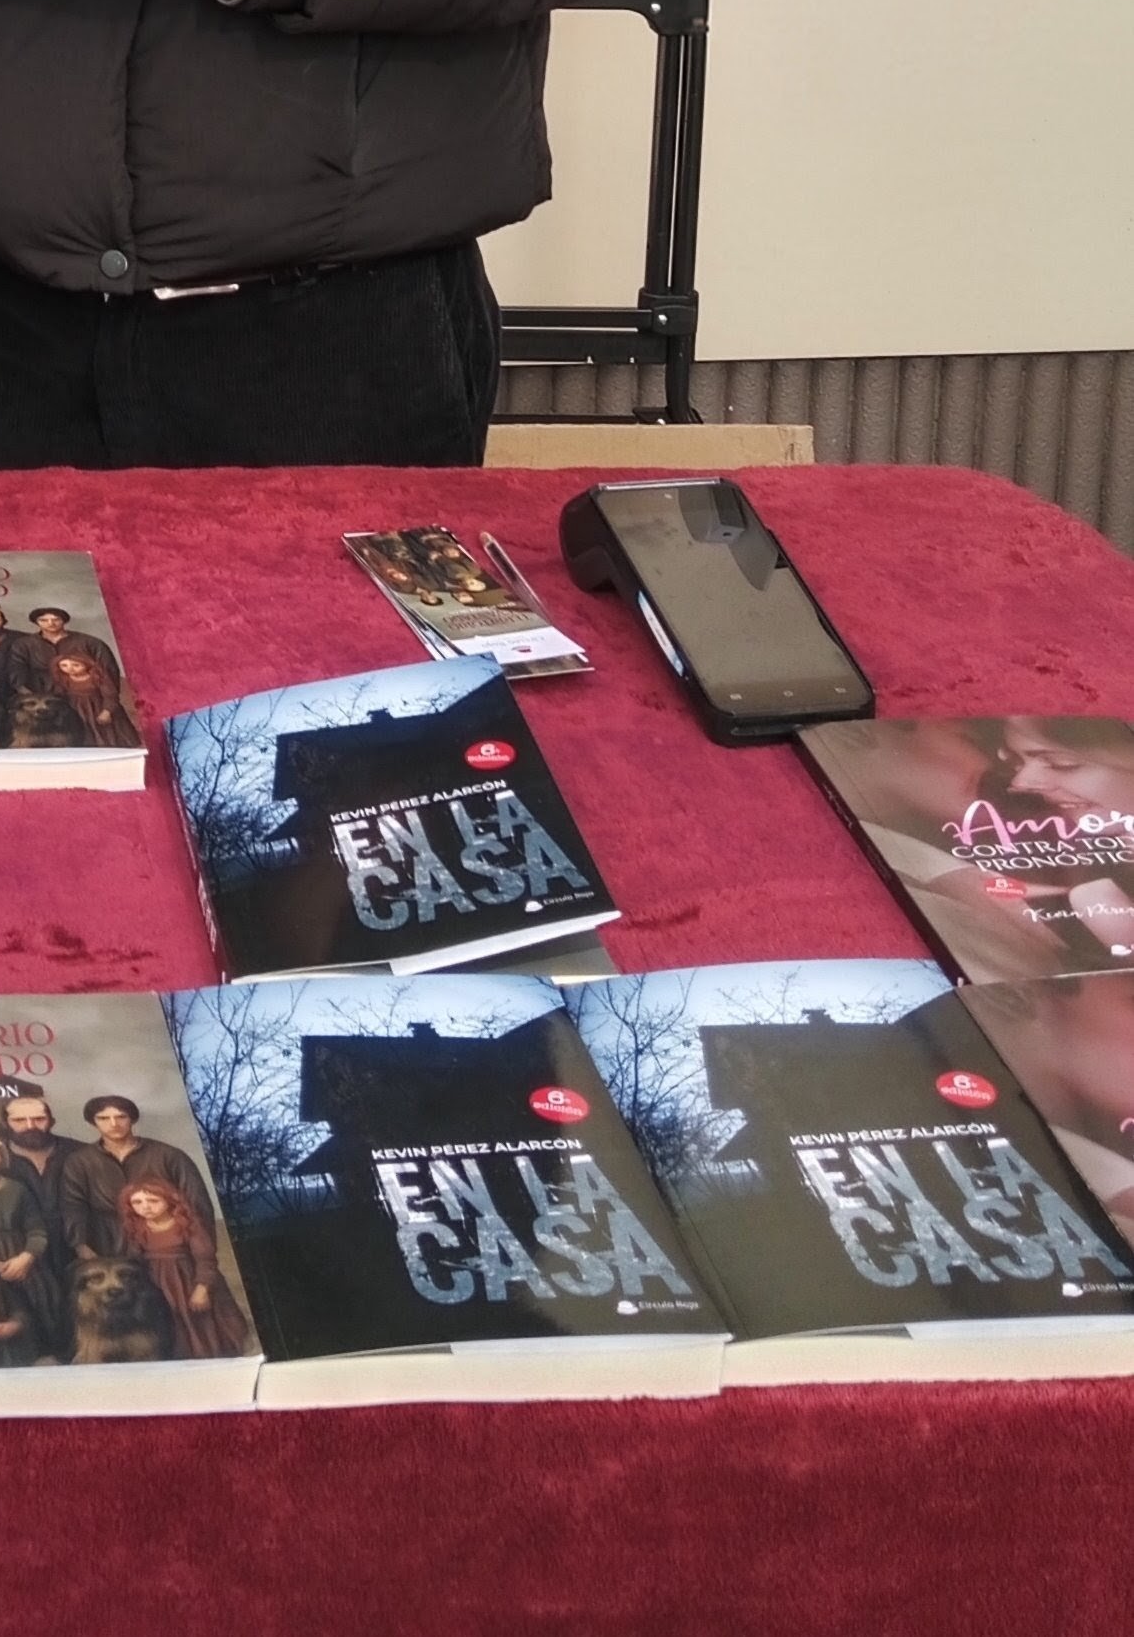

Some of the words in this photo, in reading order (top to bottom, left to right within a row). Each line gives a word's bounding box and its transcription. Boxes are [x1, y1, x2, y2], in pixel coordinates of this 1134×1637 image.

[330, 808, 377, 823] KEVIN
[379, 795, 430, 814] PÉREZ
[433, 779, 507, 803] ALARCÓN
[333, 810, 432, 871] EN
[448, 789, 534, 845] LA
[942, 800, 1134, 853] Amor
[347, 826, 591, 931] CASA
[951, 840, 1075, 859] CONTRA
[371, 1146, 427, 1161] KEVIN
[430, 1141, 490, 1157] PÉREZ
[495, 1137, 583, 1152] ALARCÓN
[789, 1132, 845, 1147] KEVIN
[847, 1127, 907, 1143] PÉREZ
[910, 1122, 997, 1138] ALARCÓN
[375, 1159, 494, 1225] EN
[515, 1154, 620, 1215] LA
[795, 1144, 915, 1209] EN
[932, 1137, 1043, 1201] LA
[397, 1211, 693, 1305] CASA
[829, 1192, 1134, 1288] CASA
